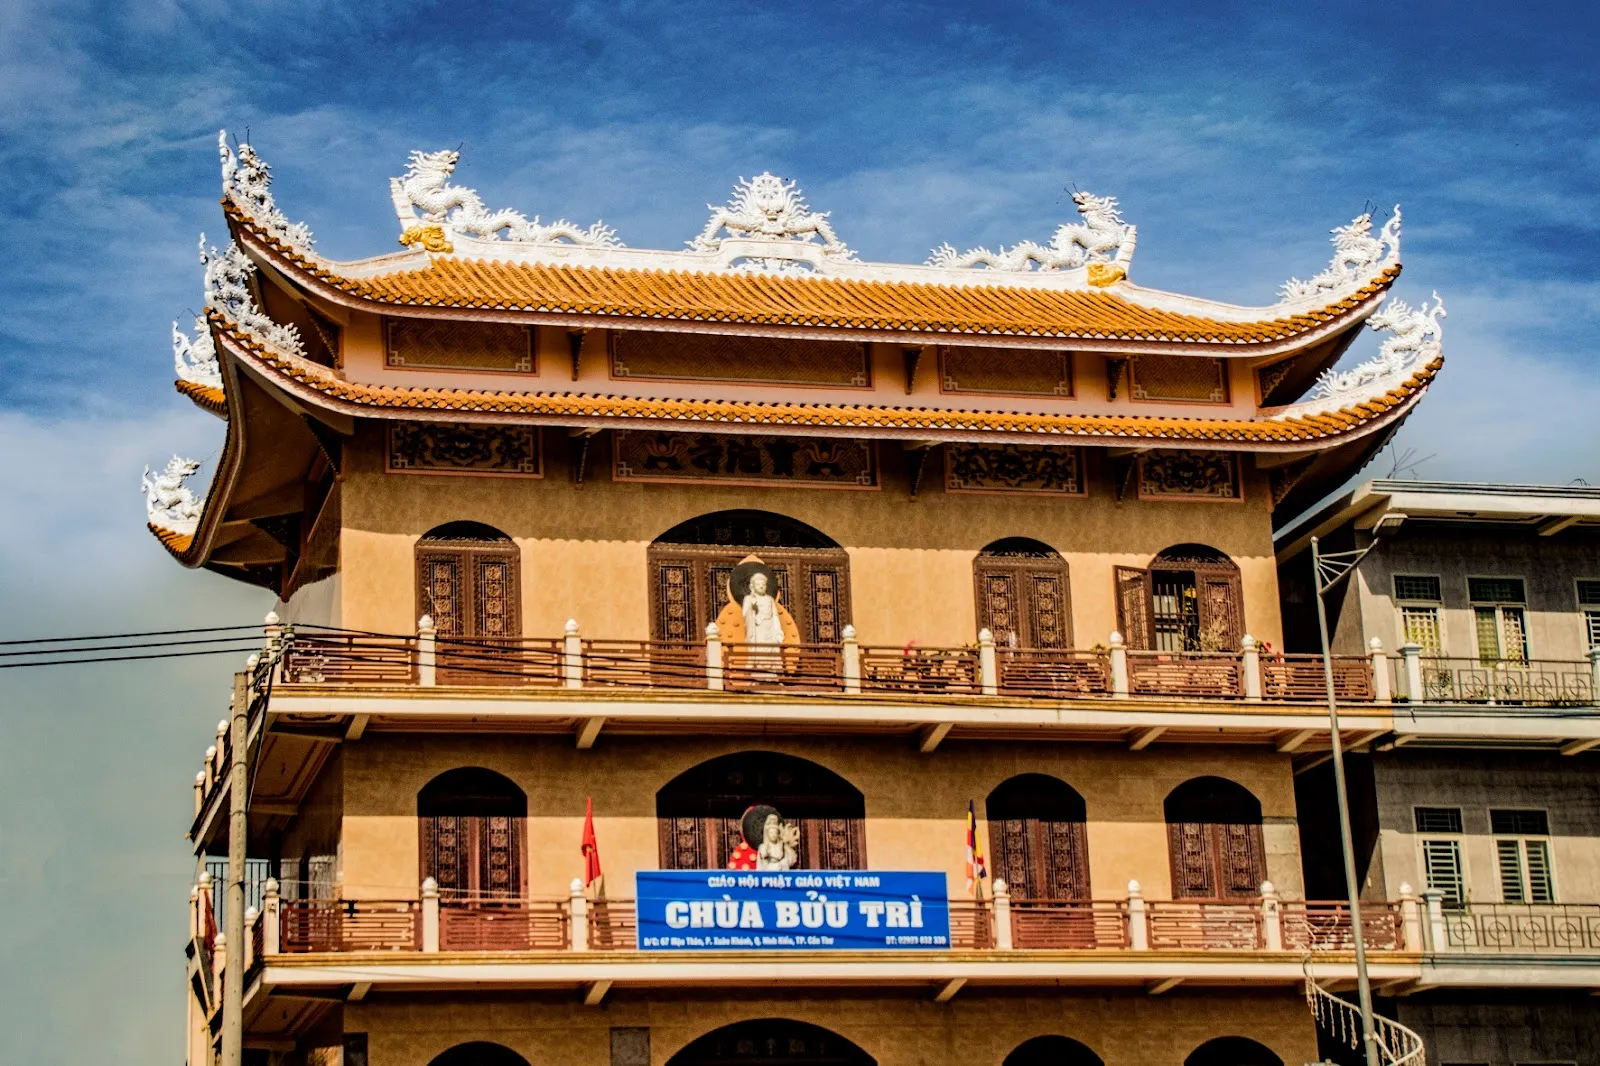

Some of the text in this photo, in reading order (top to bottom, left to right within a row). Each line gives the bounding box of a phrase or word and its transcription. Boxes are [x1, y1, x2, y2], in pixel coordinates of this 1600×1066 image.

[707, 873, 880, 889] GIÁO HỘI PHẬT GIÁO VIỆT NAM
[665, 890, 924, 929] CHÙA BỬU TRÌ
